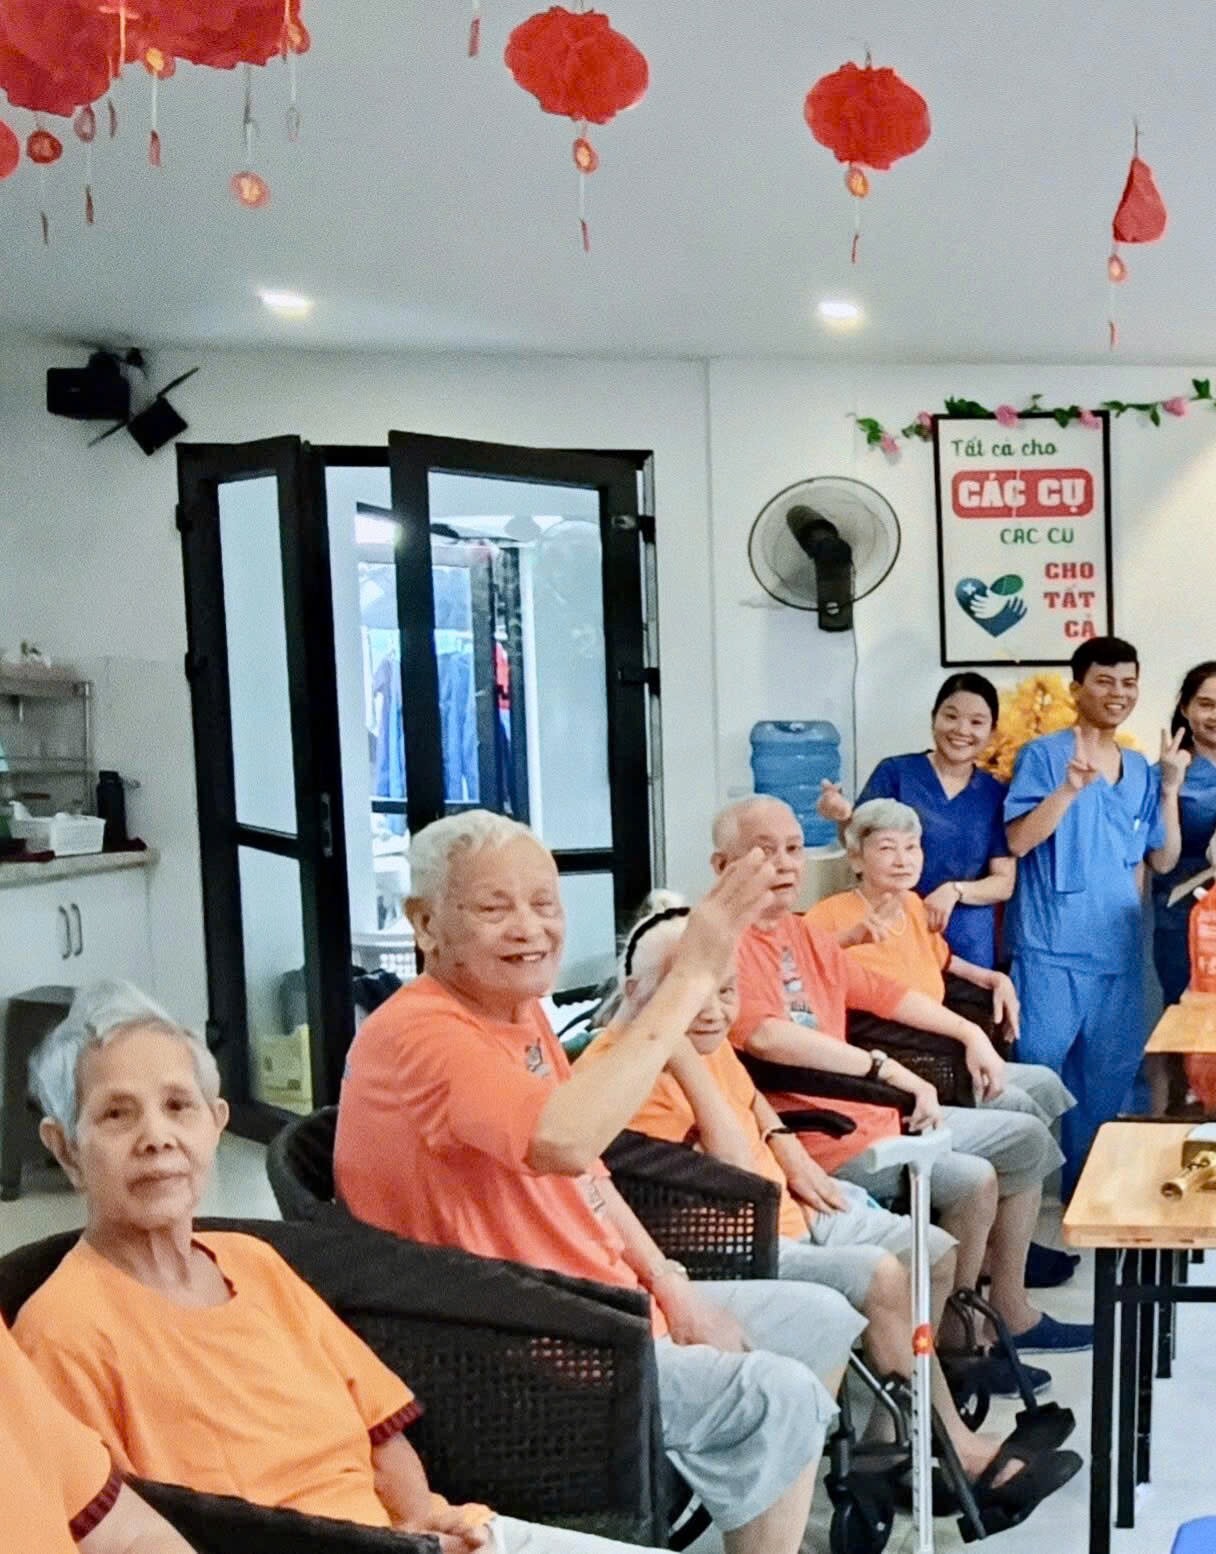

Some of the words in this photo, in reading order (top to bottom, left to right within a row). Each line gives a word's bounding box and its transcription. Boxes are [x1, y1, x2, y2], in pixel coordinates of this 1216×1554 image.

[1022, 438, 1057, 456] cho
[958, 472, 1027, 509] CÁC
[1037, 477, 1086, 513] CỤ
[1044, 561, 1095, 580] CHO
